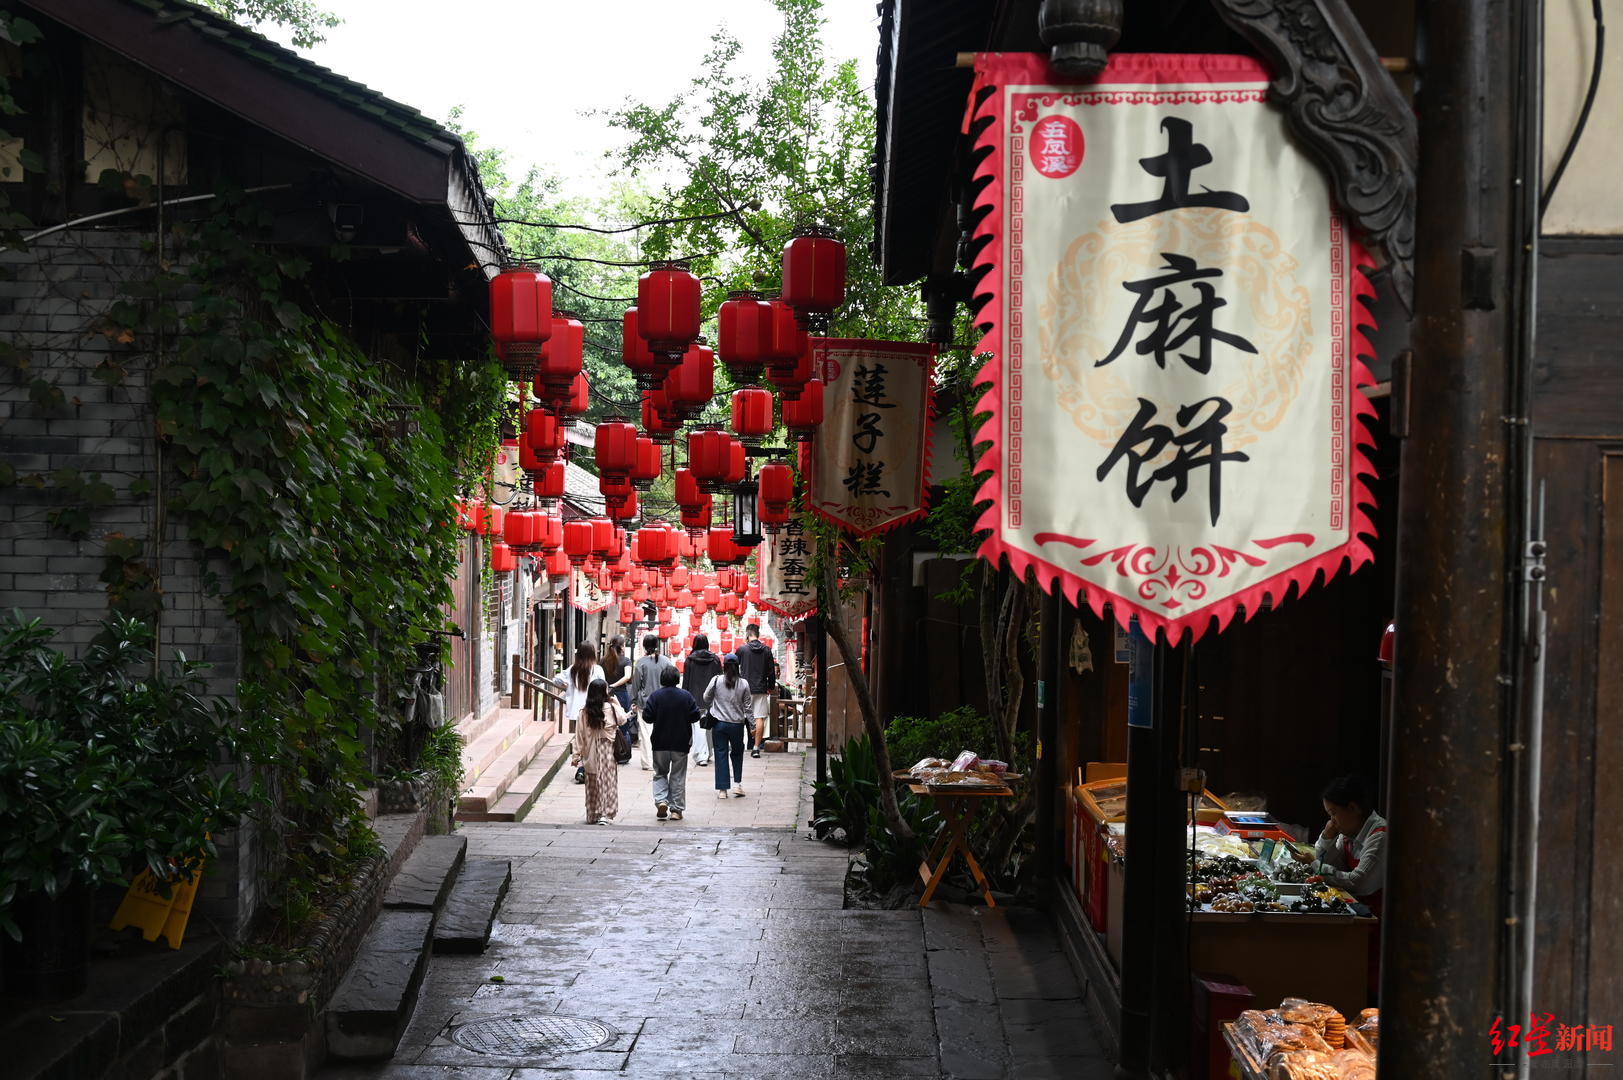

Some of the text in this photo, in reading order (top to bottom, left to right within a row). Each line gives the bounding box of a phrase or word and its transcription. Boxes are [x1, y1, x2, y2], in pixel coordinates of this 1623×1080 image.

[1039, 121, 1070, 173] 五凤溪
[1094, 116, 1258, 527] 土麻饼
[779, 518, 811, 596] 香辣蚕豆
